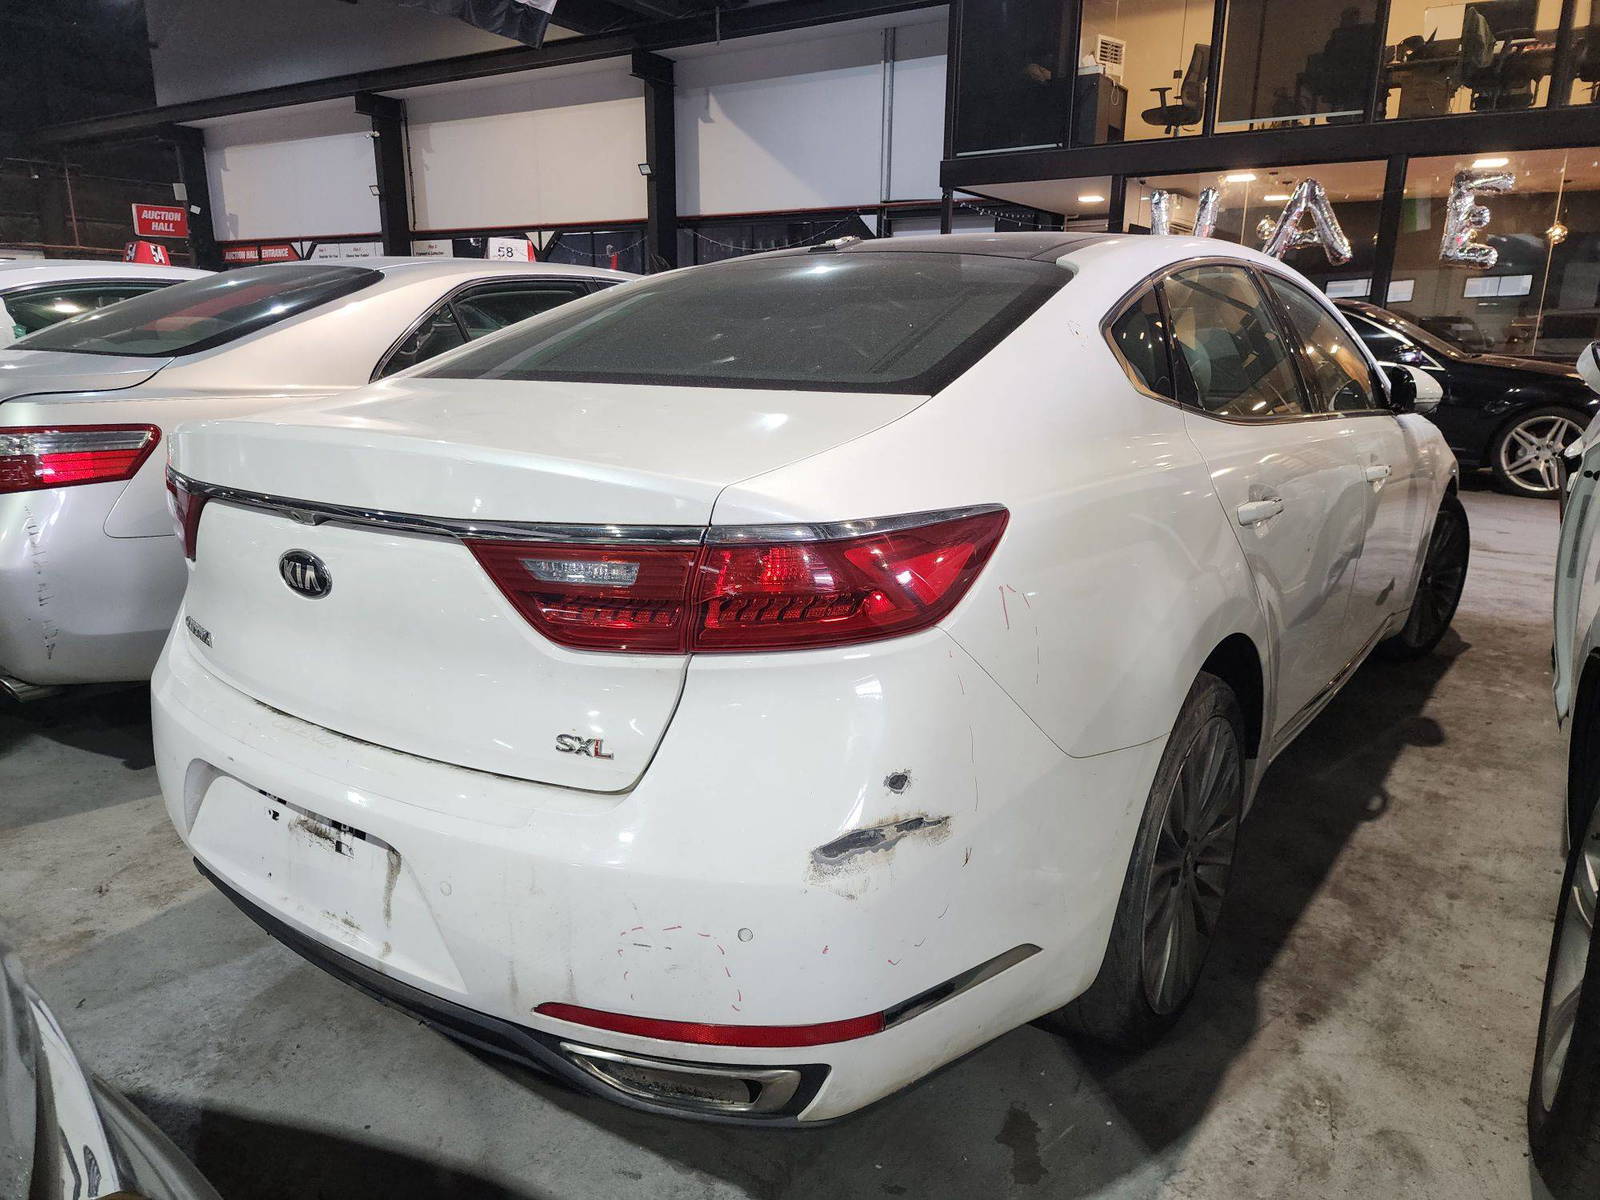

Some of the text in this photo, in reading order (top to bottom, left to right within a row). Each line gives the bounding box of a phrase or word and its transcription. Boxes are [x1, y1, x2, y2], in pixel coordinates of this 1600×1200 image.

[141, 209, 182, 221] AUCTION
[152, 222, 175, 232] HALL
[150, 244, 165, 264] 54
[498, 247, 514, 257] 58
[283, 558, 321, 591] KIA
[555, 734, 614, 760] SXL
